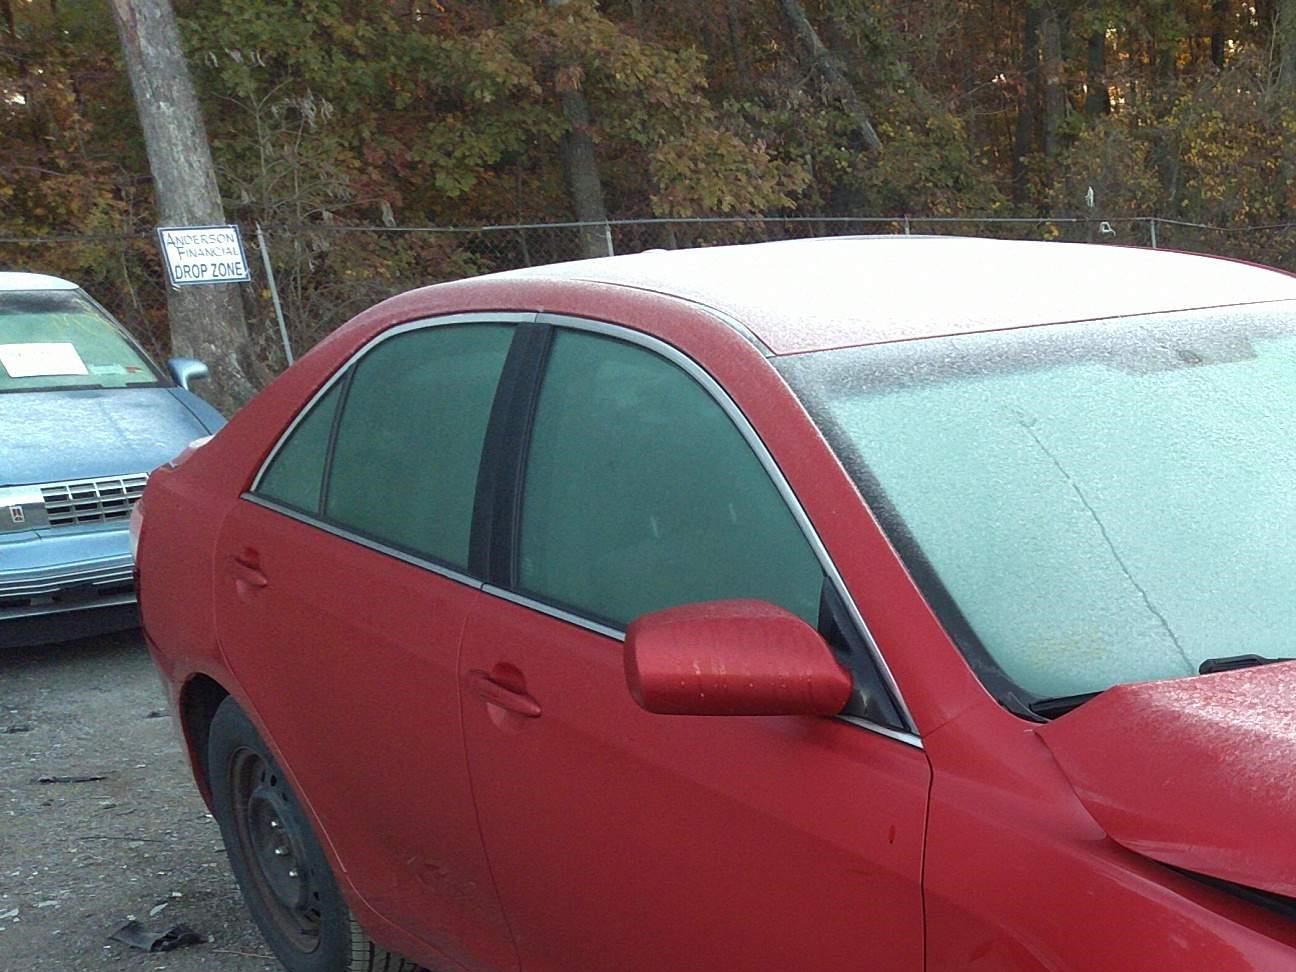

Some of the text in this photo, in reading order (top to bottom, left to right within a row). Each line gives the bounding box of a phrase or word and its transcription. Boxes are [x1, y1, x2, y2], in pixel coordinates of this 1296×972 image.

[166, 233, 235, 246] ANDERSON
[176, 246, 239, 260] FINANCIAL
[174, 262, 242, 279] DROP ZONE
